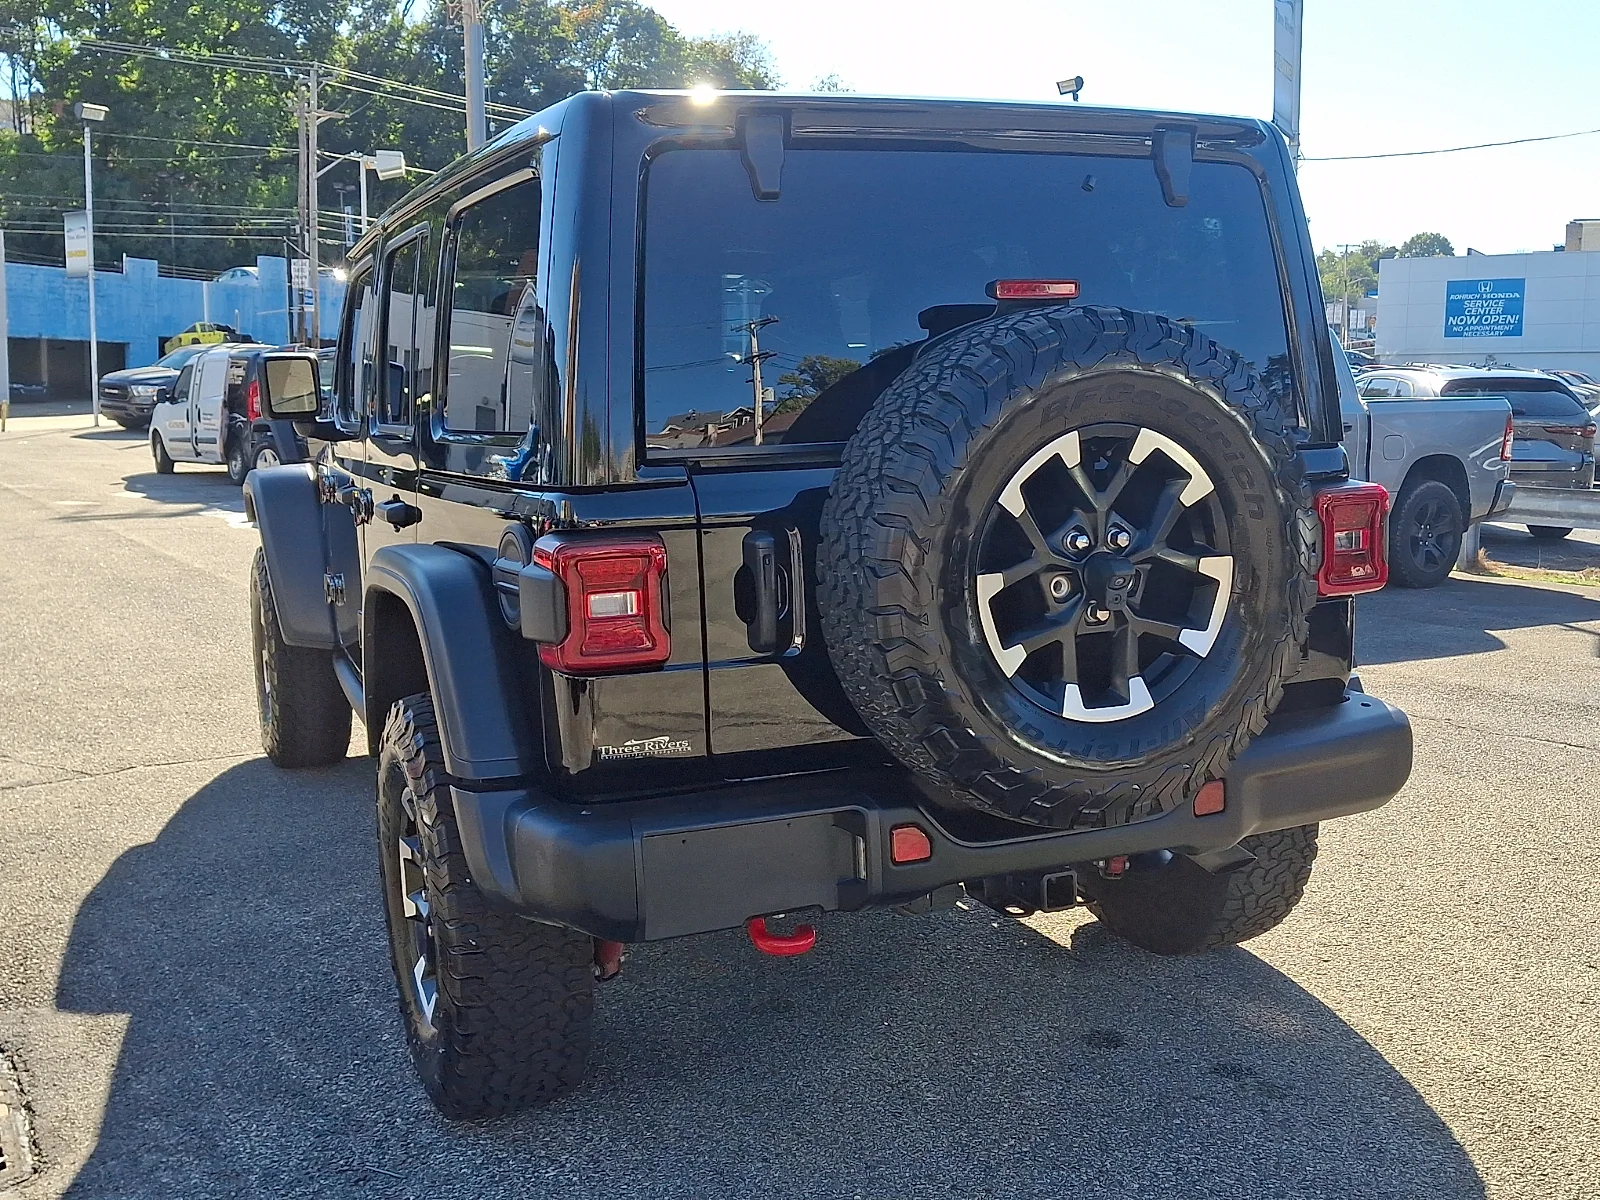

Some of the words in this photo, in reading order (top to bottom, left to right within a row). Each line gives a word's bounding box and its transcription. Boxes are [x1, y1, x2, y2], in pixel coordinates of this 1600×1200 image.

[1448, 316, 1479, 325] NOW
[1482, 315, 1519, 324] OPEN!
[598, 745, 641, 755] Three
[643, 739, 689, 751] Rivers
